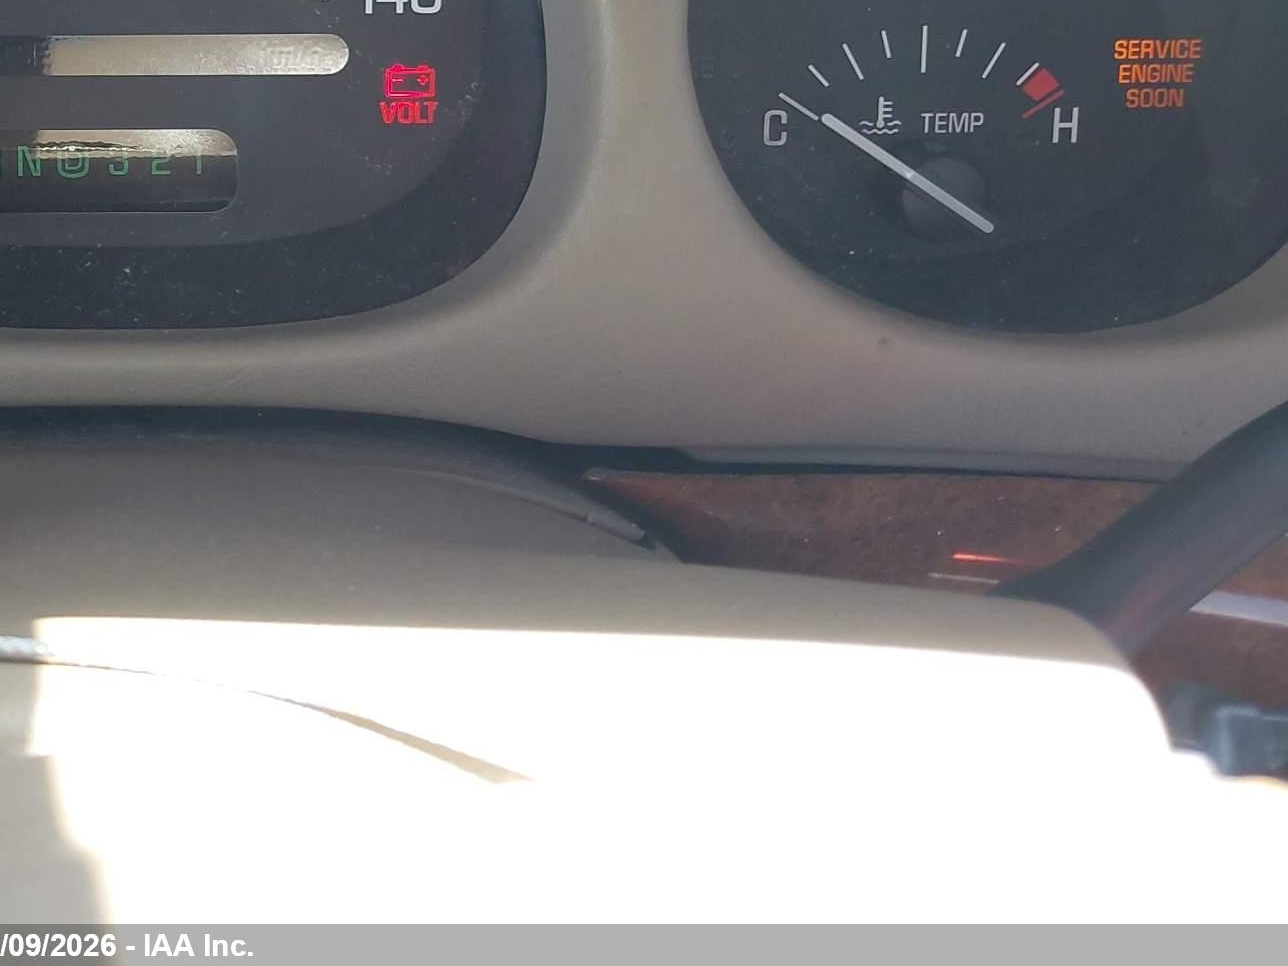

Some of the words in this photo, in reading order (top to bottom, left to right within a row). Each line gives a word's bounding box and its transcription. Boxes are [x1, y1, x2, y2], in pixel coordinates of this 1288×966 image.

[1114, 39, 1201, 59] SERVICE
[1118, 64, 1193, 84] ENGINE
[1127, 89, 1182, 107] SOON
[380, 101, 438, 124] VOLT
[921, 113, 983, 133] TEMP
[764, 110, 787, 145] C
[1053, 107, 1079, 143] H
[17, 145, 41, 177] N
